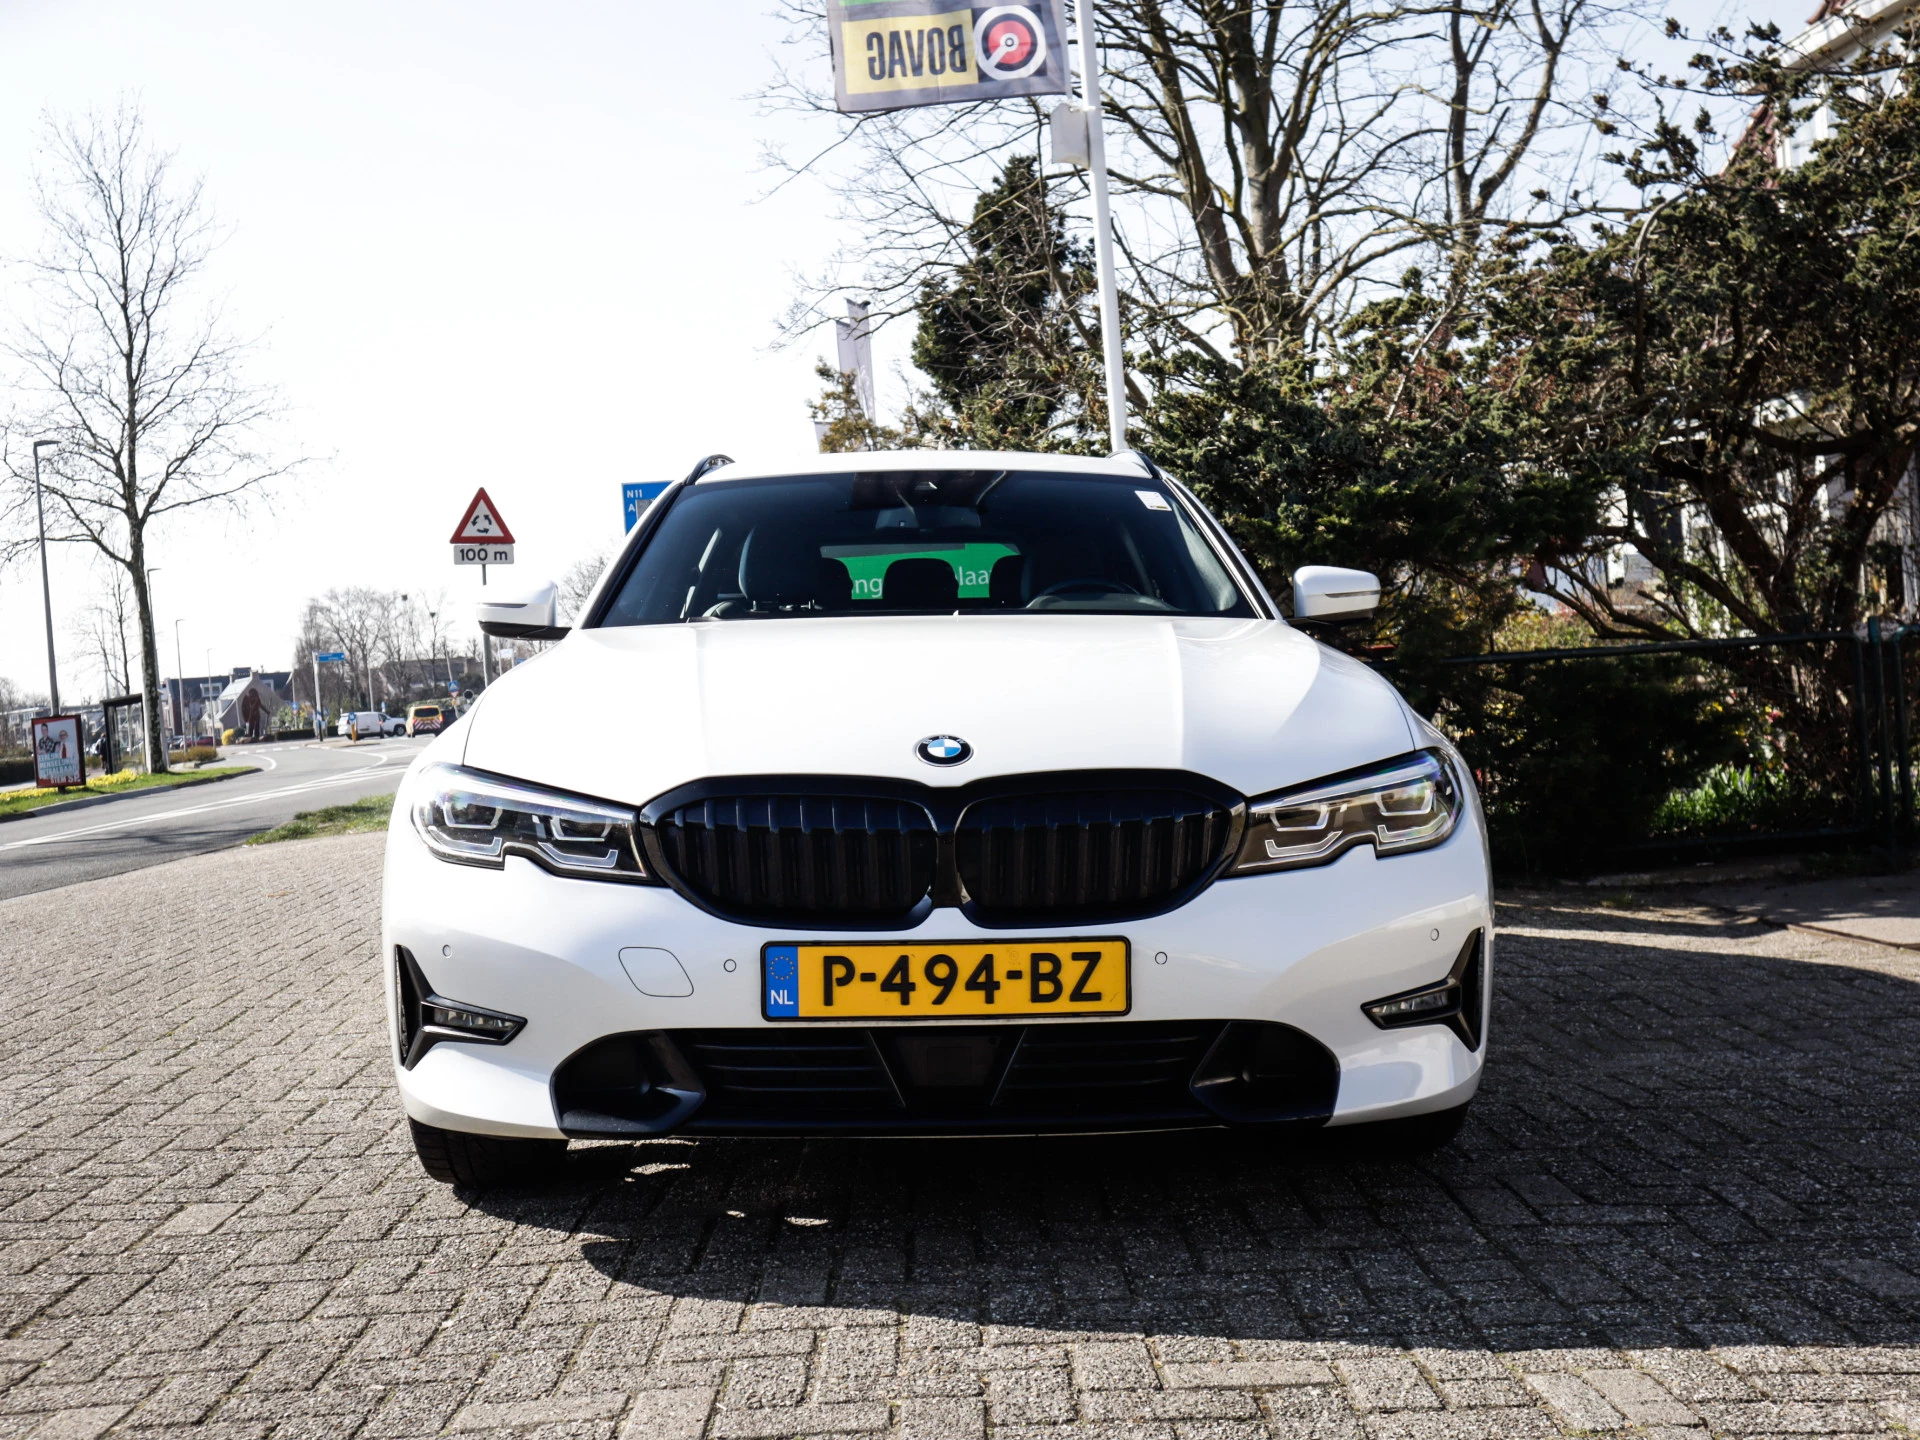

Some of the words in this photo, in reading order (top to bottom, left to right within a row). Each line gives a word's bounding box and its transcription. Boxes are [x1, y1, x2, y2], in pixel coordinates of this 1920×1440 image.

[626, 489, 643, 499] N11
[459, 548, 488, 562] 100
[493, 550, 508, 561] m
[851, 577, 883, 598] ng
[955, 565, 992, 586] laa
[823, 952, 1103, 1007] P-494-BZ
[770, 989, 794, 1005] NL
